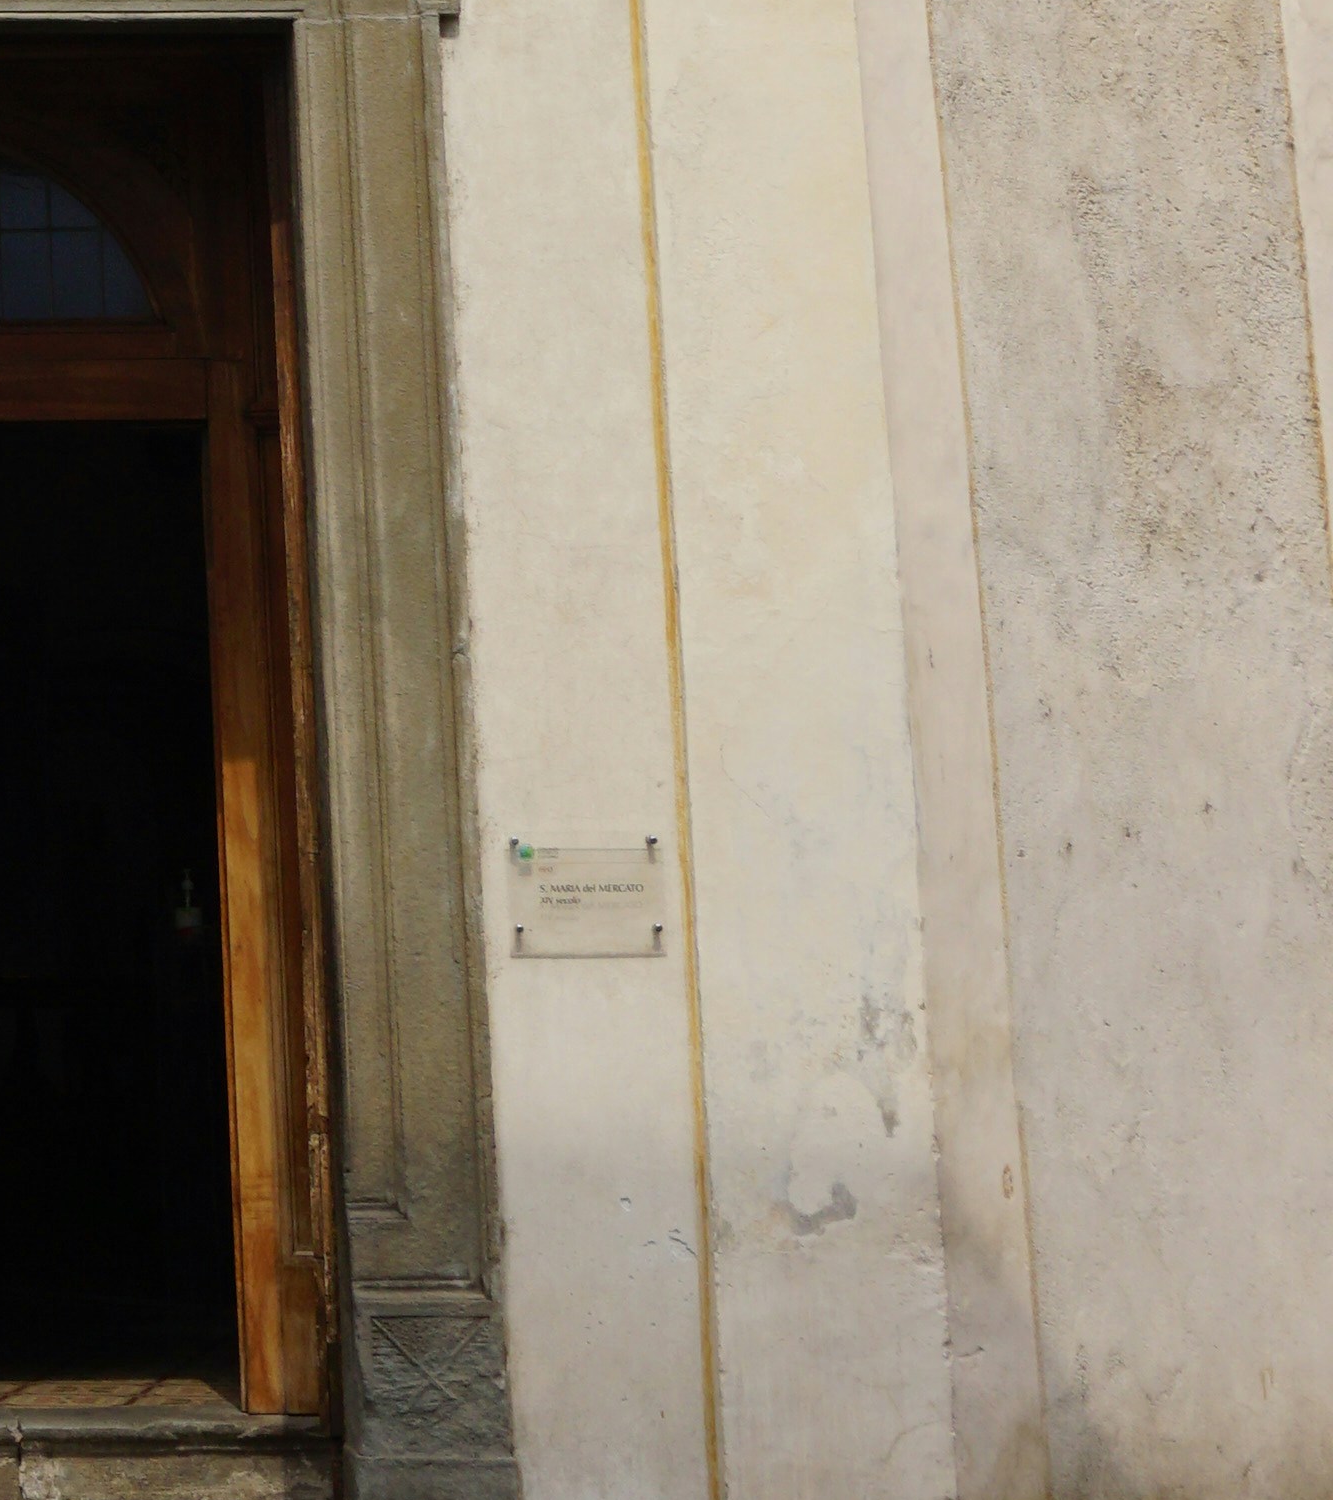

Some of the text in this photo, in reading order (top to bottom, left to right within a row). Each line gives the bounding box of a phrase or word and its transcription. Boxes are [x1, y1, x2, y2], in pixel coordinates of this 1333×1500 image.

[550, 884, 581, 893] MARIA
[582, 884, 596, 893] del
[598, 883, 644, 893] MERCATO
